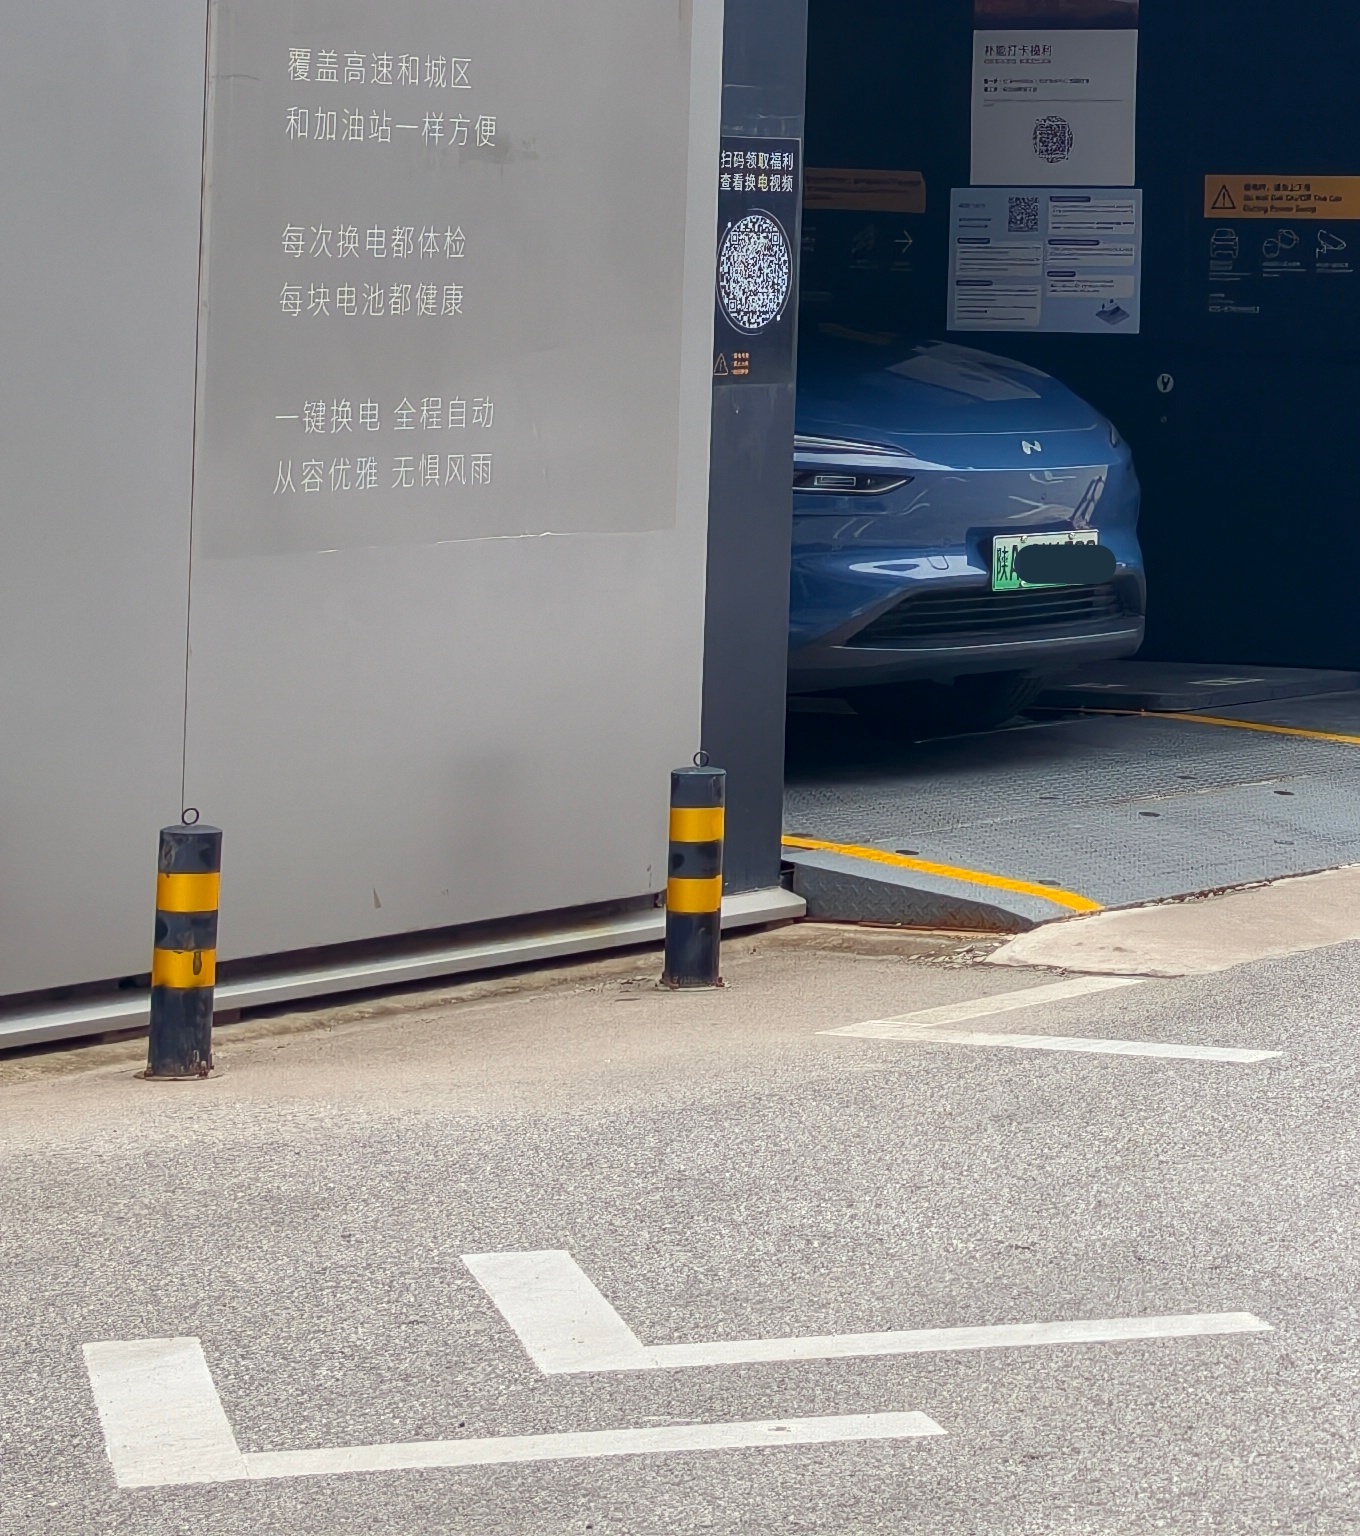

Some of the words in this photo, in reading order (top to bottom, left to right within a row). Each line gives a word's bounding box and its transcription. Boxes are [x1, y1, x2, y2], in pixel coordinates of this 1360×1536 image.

[288, 47, 472, 89] 覆盖高速和城区
[285, 106, 497, 147] 和加油站一样方便
[720, 150, 794, 171] 扫码领取福利
[719, 173, 793, 192] 查看换电视频
[281, 223, 466, 260] 每次换电都体检
[279, 282, 464, 317] 每块电池都健康
[275, 397, 380, 434] 一键换电
[393, 395, 494, 431] 全程自动
[273, 456, 379, 495] 从容优雅
[391, 453, 493, 489] 无惧风雨
